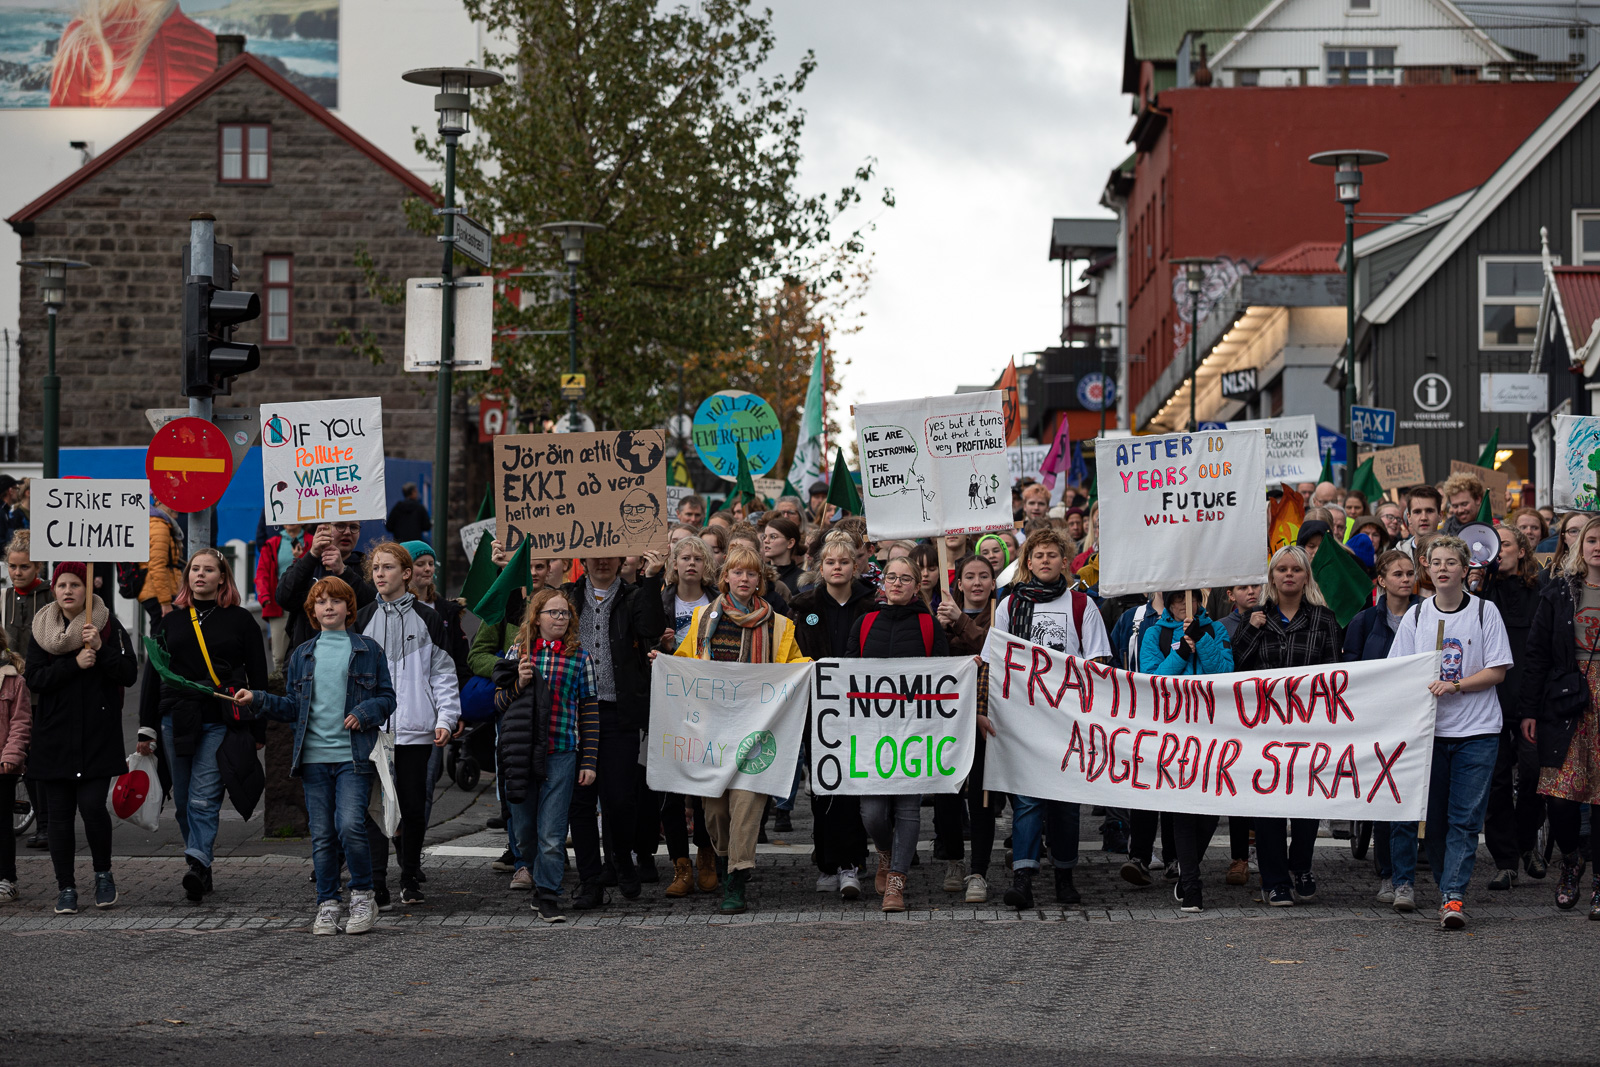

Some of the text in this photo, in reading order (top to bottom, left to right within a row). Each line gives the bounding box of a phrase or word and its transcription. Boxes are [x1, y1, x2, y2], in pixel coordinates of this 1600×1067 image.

[1222, 370, 1256, 395] NLSN
[706, 397, 769, 422] PULL THE
[293, 418, 365, 447] IF YOU
[929, 415, 1003, 437] yes but it turns
[1355, 411, 1390, 432] TAXI
[1400, 421, 1457, 429] INFORMATION
[695, 424, 778, 447] EMERGENCY
[864, 430, 904, 443] WE ARE
[933, 428, 992, 441] out that it is
[1266, 440, 1304, 449] ECONOMY
[296, 445, 354, 467] Pollute
[502, 439, 611, 471] Jörðin ætti
[867, 445, 916, 458] DESTROYING
[935, 438, 1003, 456] very PROFITABLE
[1116, 436, 1224, 466] AFTER 10
[1266, 449, 1304, 458] ALLIANCE
[714, 451, 770, 477] BRKE
[869, 463, 889, 473] THE
[1386, 462, 1413, 476] REBEL
[294, 464, 361, 488] WATER
[503, 470, 645, 502] EKKI að vera
[872, 474, 904, 488] EARTH
[1119, 461, 1232, 493] YEARS OUR
[121, 493, 145, 510] FOR
[296, 484, 359, 499] you Pollute
[1162, 491, 1237, 511] FUTURE
[297, 496, 357, 521] LIFE
[505, 503, 575, 522] heitari en
[1144, 509, 1225, 526] WILL END
[505, 524, 565, 552] Danny
[570, 520, 620, 549] DeVito
[665, 674, 801, 703] EVERY DAY
[849, 674, 958, 718] NOMIC
[1233, 670, 1354, 729] OKKAR
[687, 704, 700, 723] is
[663, 733, 728, 767] FRIDAY
[849, 735, 957, 779] LOGIC
[1252, 741, 1406, 803] STRAX
